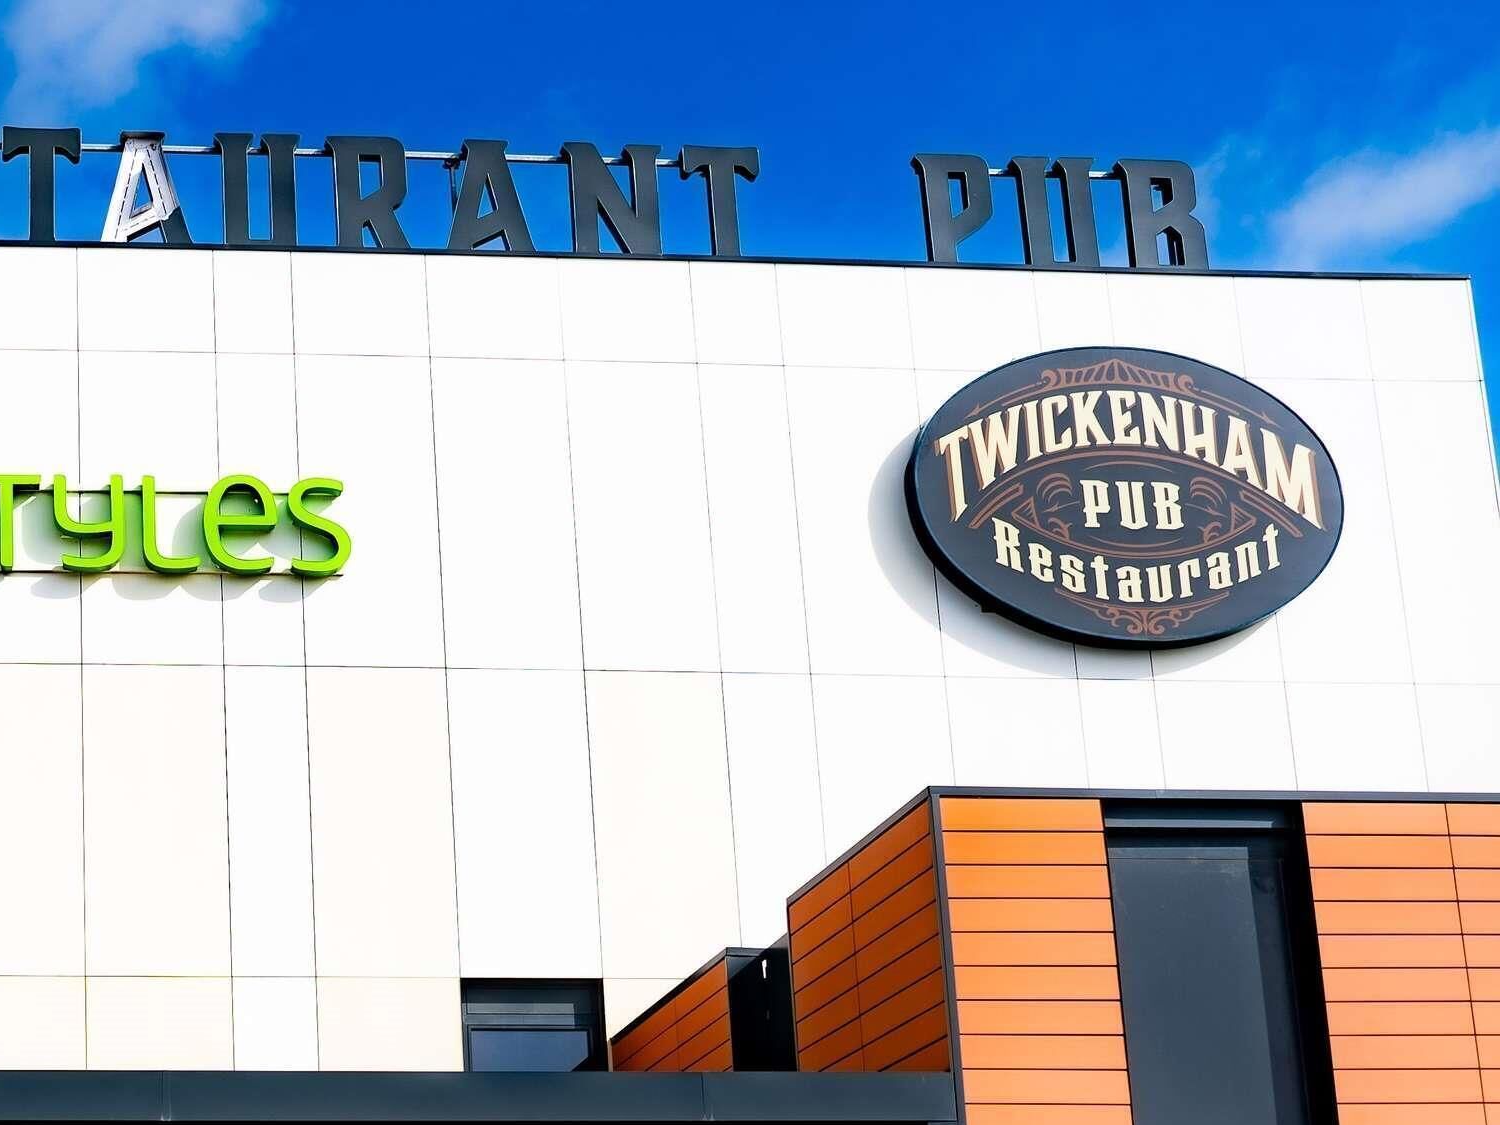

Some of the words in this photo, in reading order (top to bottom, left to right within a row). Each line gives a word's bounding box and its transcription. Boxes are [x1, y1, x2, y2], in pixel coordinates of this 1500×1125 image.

[910, 153, 1210, 270] PUB
[934, 389, 1326, 530] TWICKENHAM
[1078, 479, 1185, 531] PUB
[991, 517, 1280, 604] Restaurant
